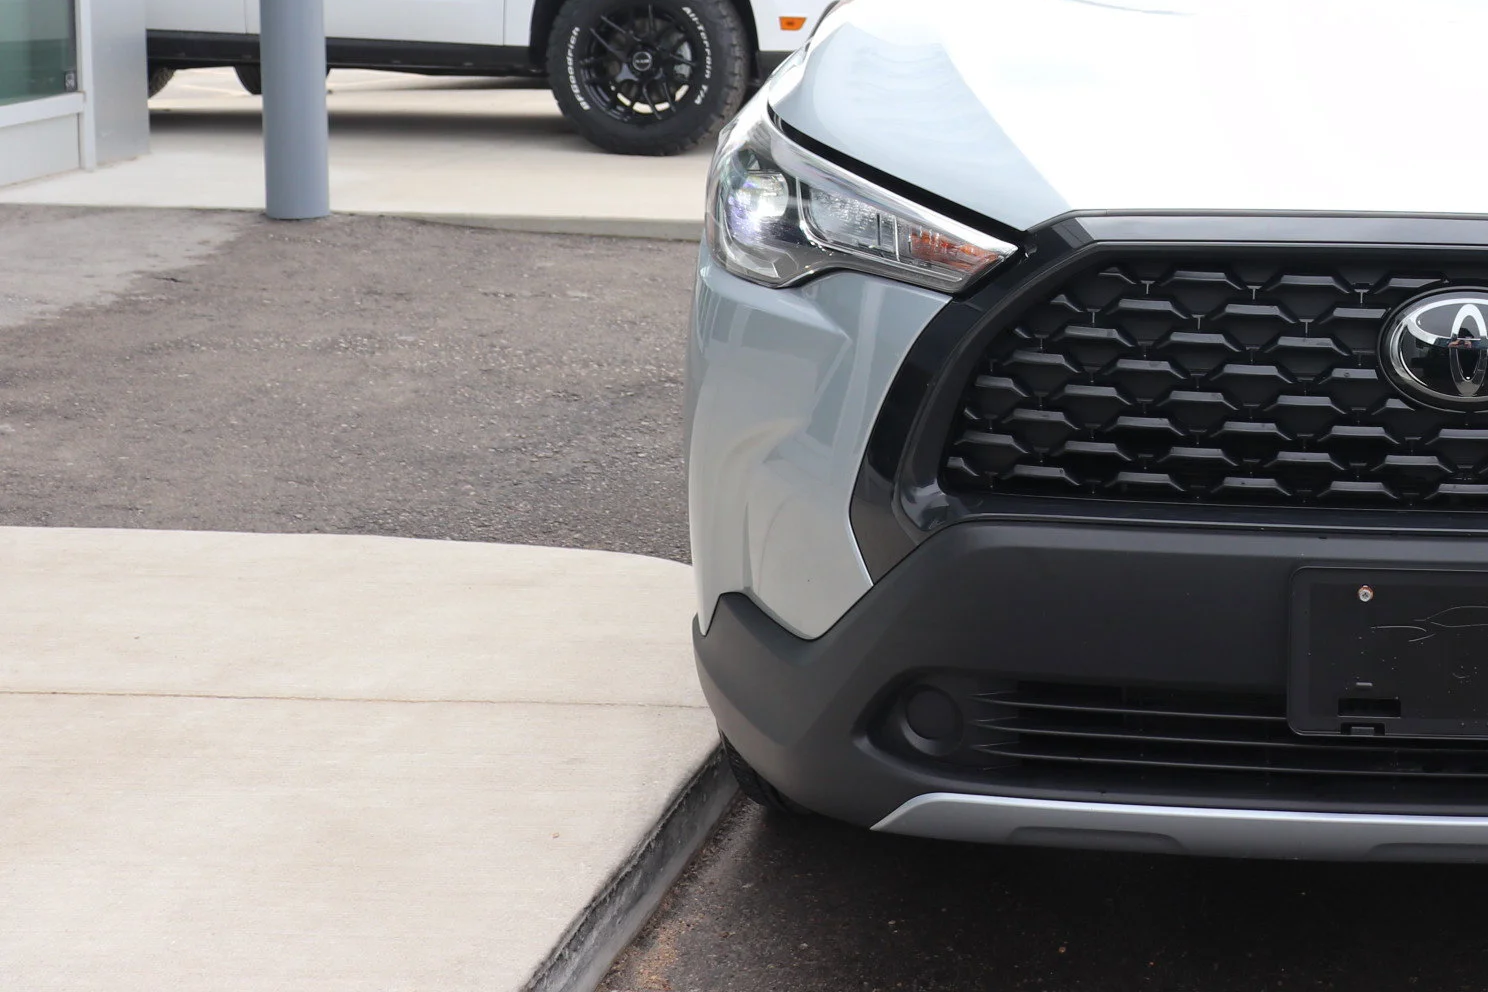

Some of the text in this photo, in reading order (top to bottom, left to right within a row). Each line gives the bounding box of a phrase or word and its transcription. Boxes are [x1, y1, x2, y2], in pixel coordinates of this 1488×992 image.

[566, 26, 591, 110] BFGoodrich
[681, 6, 712, 105] All-Terrain T/A
